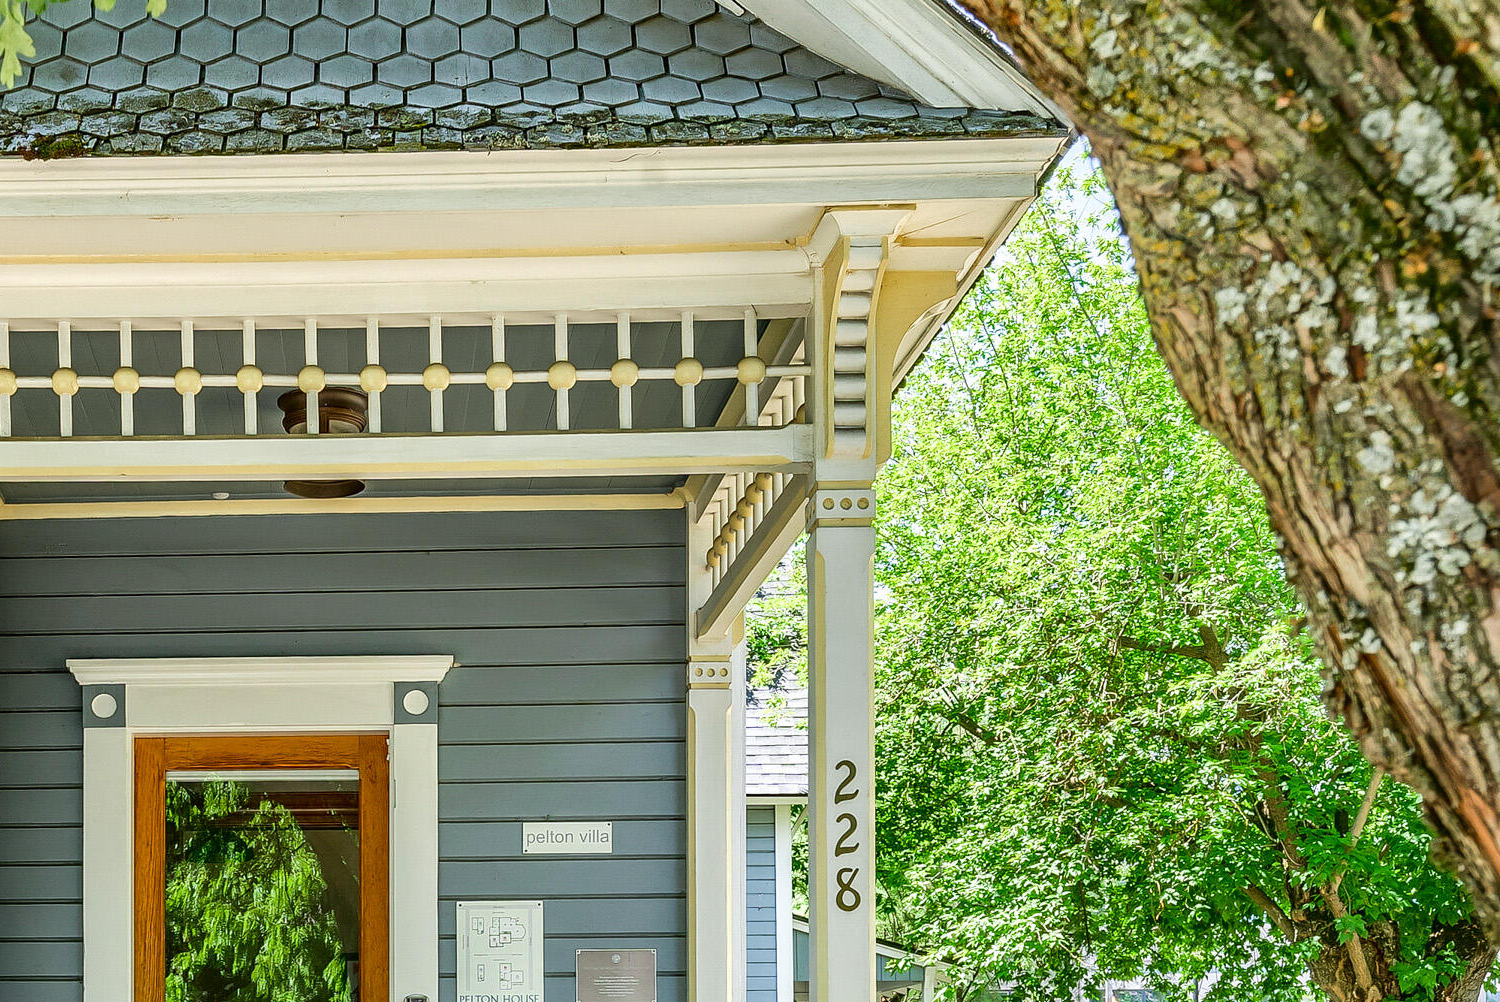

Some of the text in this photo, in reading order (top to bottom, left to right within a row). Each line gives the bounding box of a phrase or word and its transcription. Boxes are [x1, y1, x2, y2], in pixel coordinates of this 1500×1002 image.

[526, 829, 609, 847] pelton villa
[834, 759, 861, 912] 228
